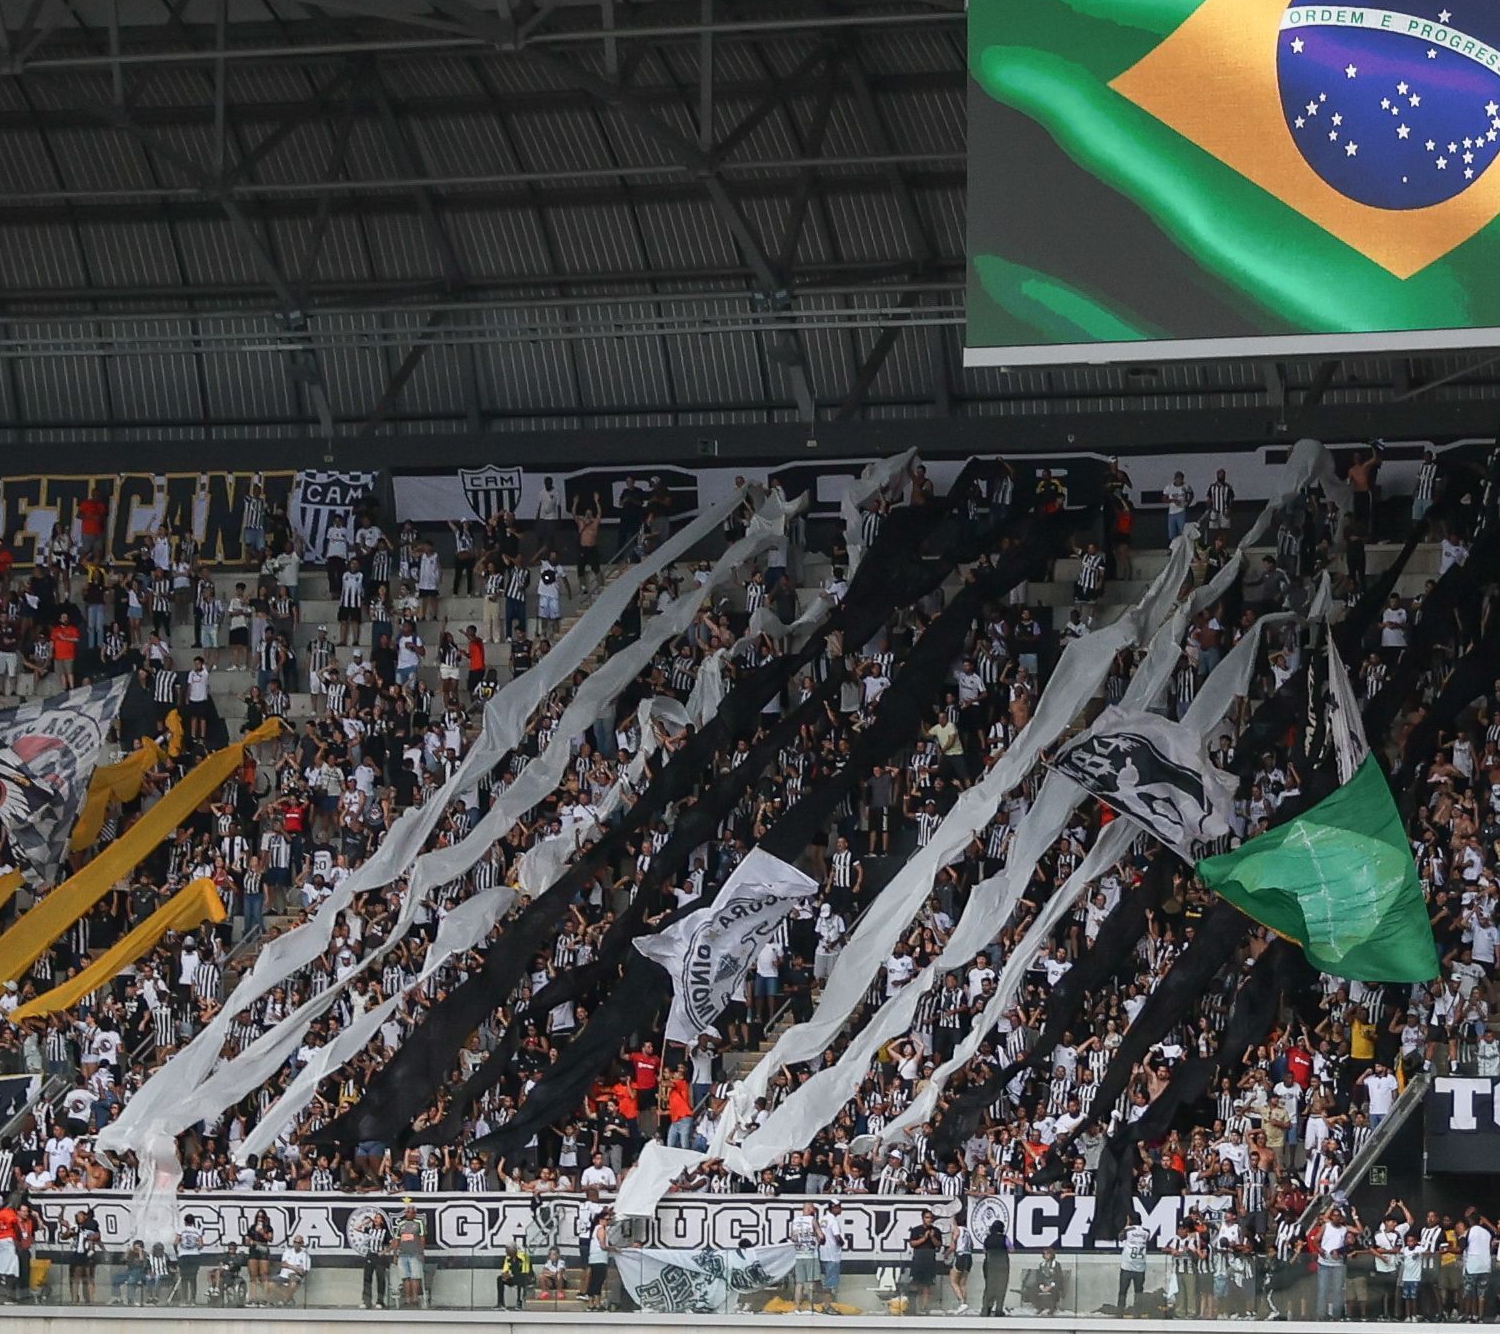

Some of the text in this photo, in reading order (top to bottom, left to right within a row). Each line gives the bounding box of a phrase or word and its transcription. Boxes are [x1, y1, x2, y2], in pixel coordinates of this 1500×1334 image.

[1289, 8, 1367, 27] ORDEM
[1379, 13, 1393, 28] E
[470, 475, 515, 488] CAM
[306, 483, 363, 505] CAM
